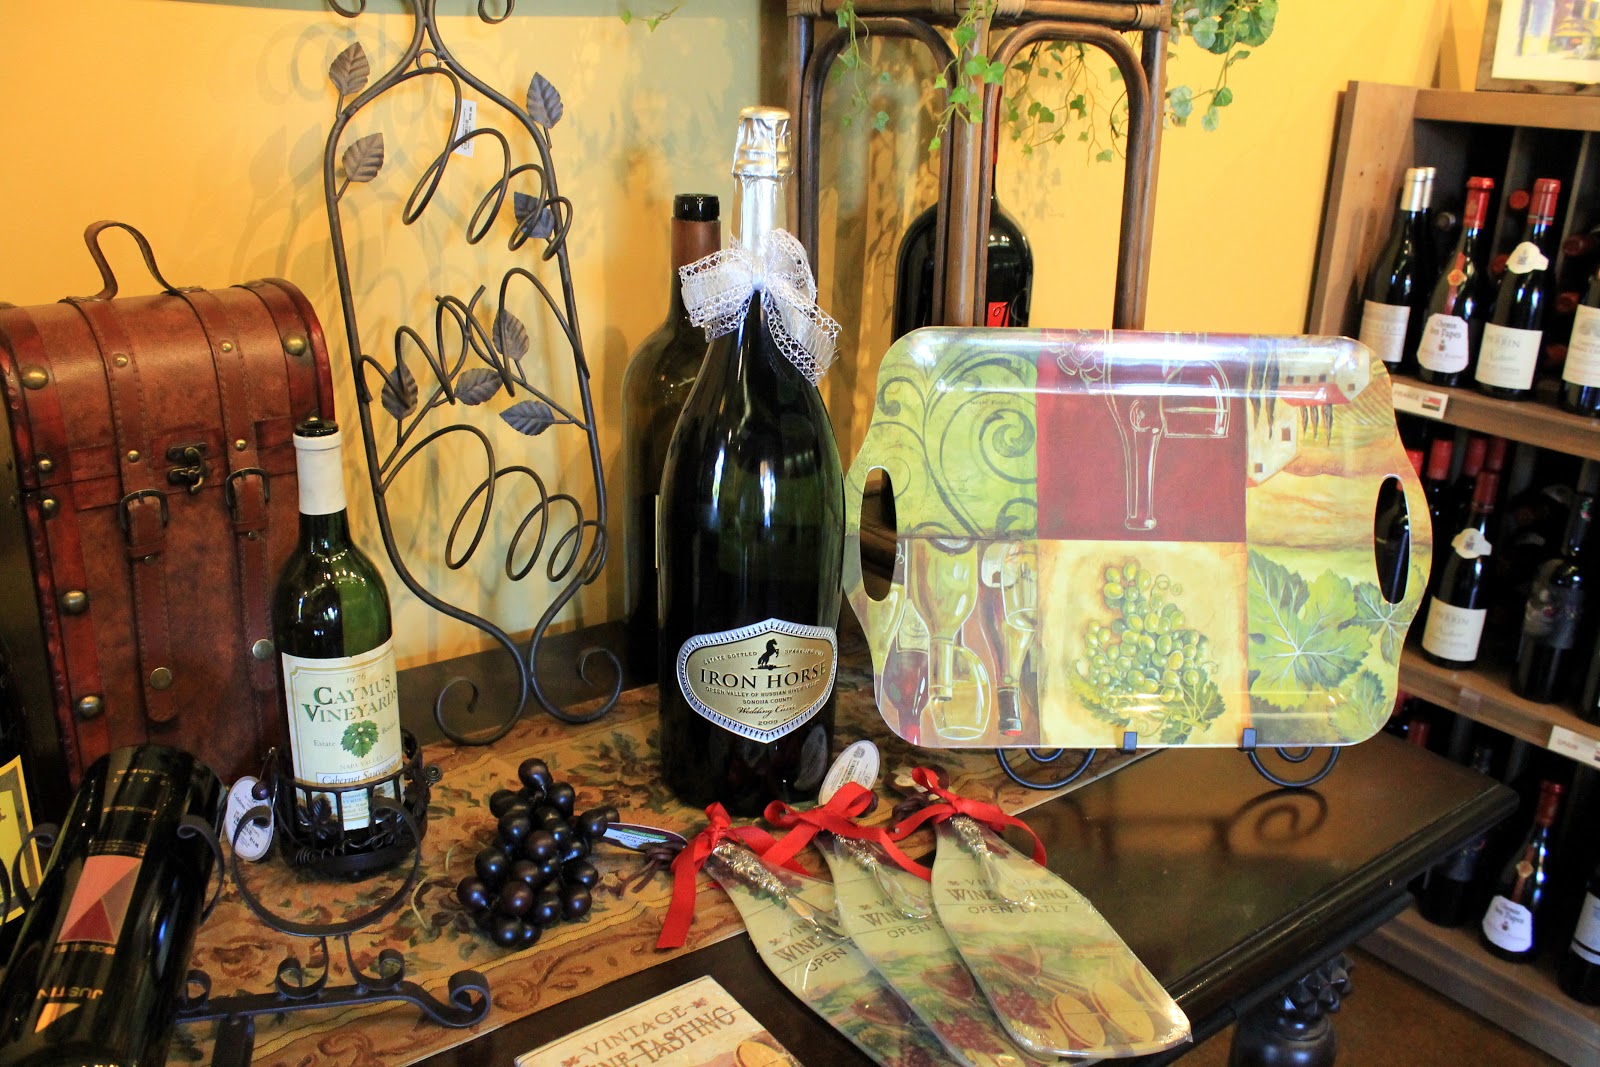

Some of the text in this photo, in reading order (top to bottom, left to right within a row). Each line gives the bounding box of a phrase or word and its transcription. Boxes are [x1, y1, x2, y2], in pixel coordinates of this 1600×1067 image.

[727, 651, 758, 660] BOTTLED
[346, 671, 367, 685] 1976
[700, 659, 826, 689] IRON HORSE
[313, 674, 392, 706] CAYMUS
[727, 690, 749, 698] VALLEY
[770, 696, 794, 704] COUNTY
[736, 704, 774, 719] Wedding
[313, 740, 336, 748] Estate
[360, 753, 384, 767] VALLEY
[321, 774, 361, 785] Cabernet
[967, 905, 1014, 914] OPEN
[887, 923, 932, 938] OPEN
[773, 935, 824, 963] WINE
[805, 947, 848, 972] OPEN
[36, 986, 104, 1000] JUSTIN
[582, 1004, 689, 1056] VINTAGE
[630, 1005, 737, 1064] TASTING
